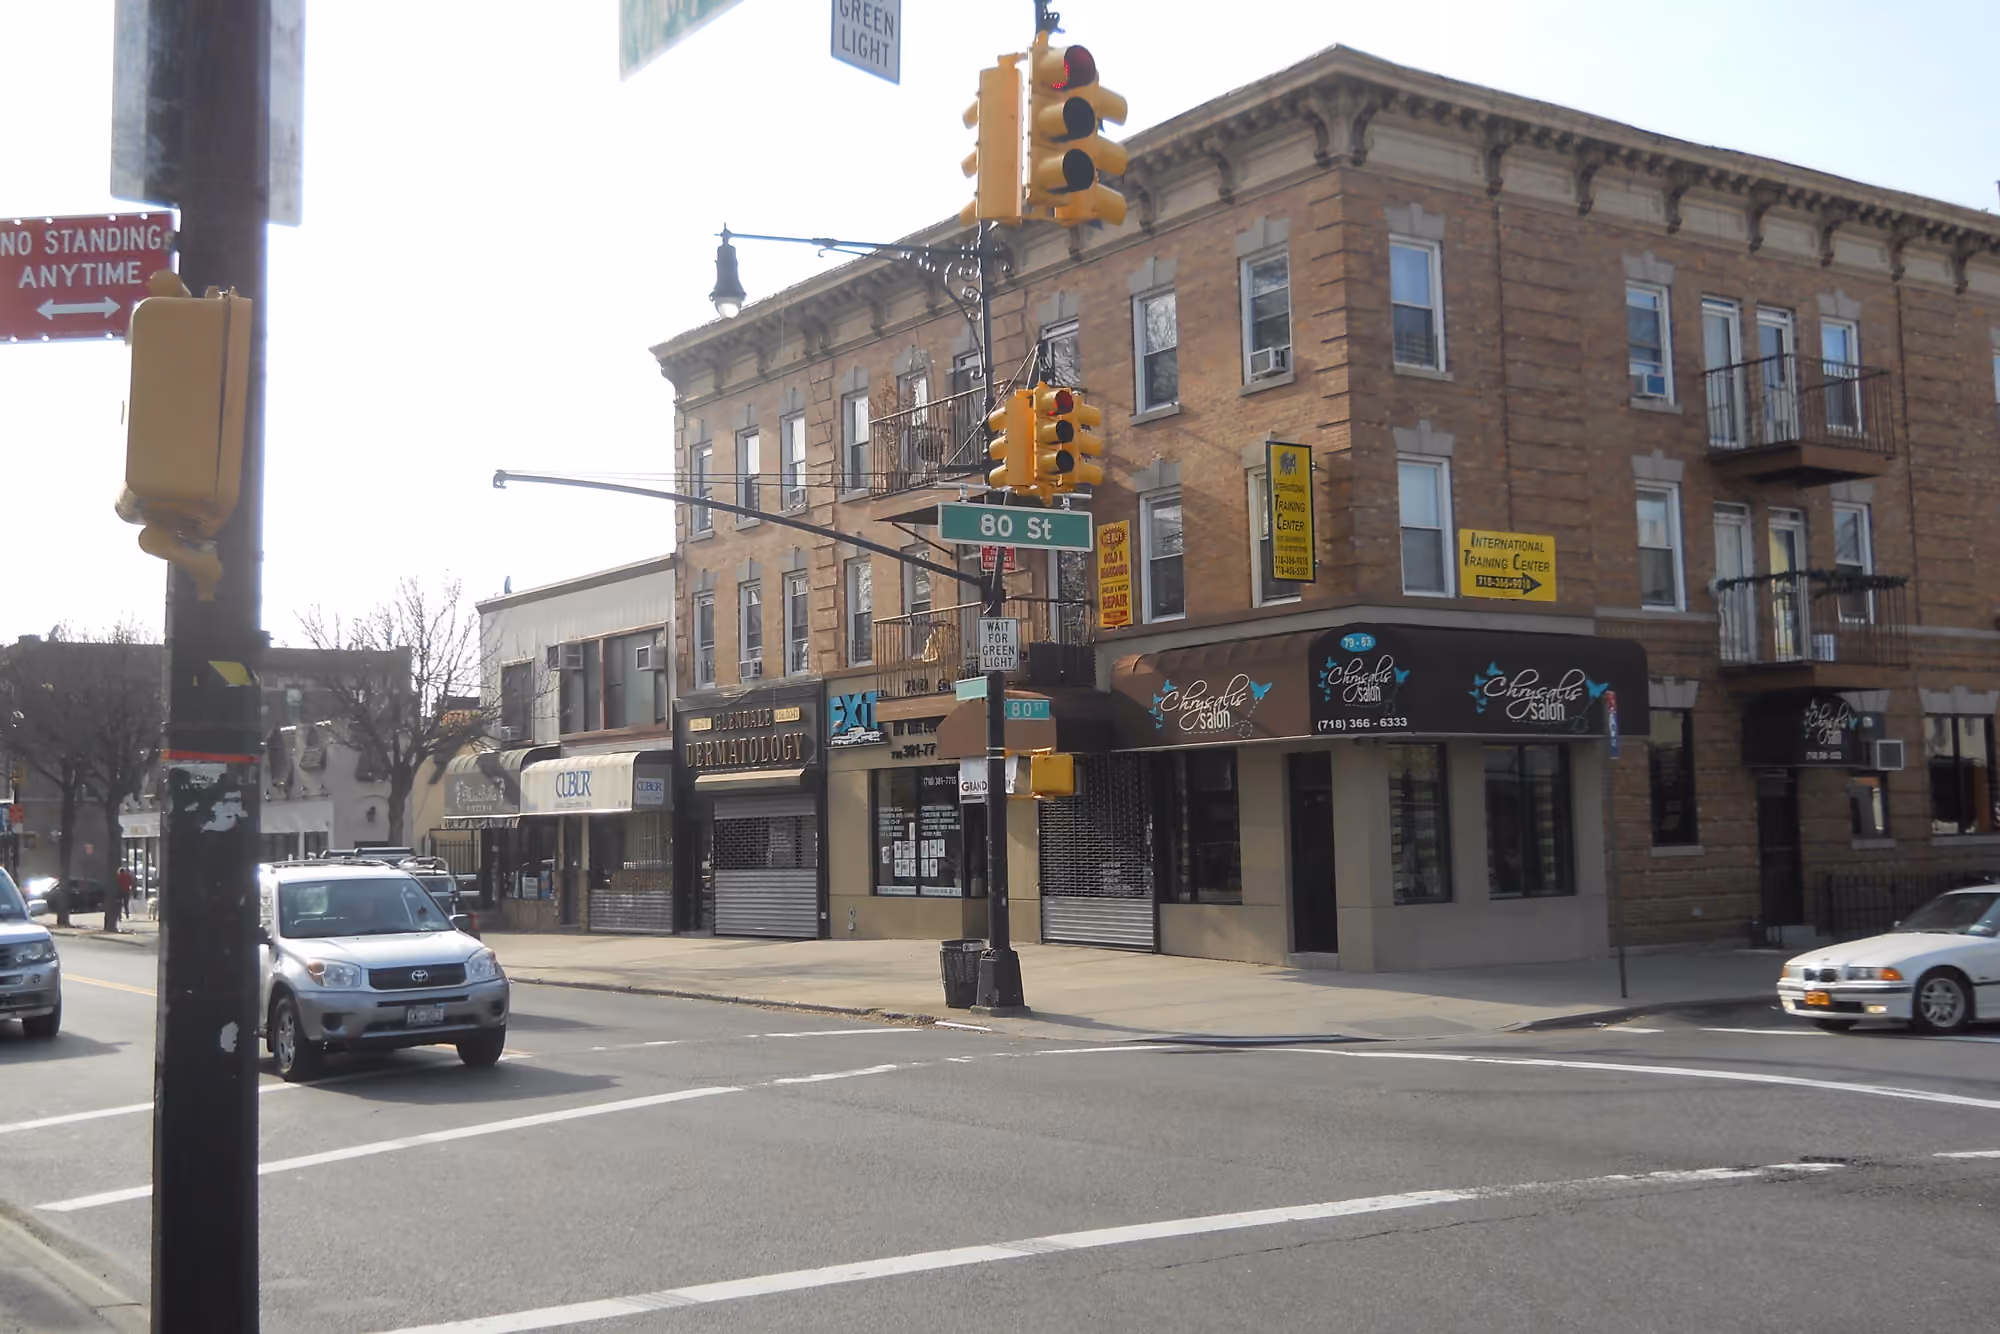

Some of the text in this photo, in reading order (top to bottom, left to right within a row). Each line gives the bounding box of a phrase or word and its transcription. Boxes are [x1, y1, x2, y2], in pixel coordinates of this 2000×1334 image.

[840, 0, 893, 40] GREEN
[842, 24, 890, 68] LIGHT
[1, 225, 161, 256] NO STANDING
[18, 261, 143, 289] ANYTIME
[1274, 494, 1306, 513] TRAINING
[980, 513, 1053, 540] 80 St
[1276, 513, 1305, 531] CENTER
[1471, 532, 1545, 553] INTERNATIONAL
[1464, 550, 1551, 573] TRAINING CENTER
[1103, 593, 1128, 610] REPAIR
[986, 621, 1010, 632] WAIT
[988, 633, 1009, 644] FOR
[982, 645, 1015, 656] GREEN
[984, 657, 1013, 669] LIGHT
[1327, 655, 1394, 703] Chrysalis
[1160, 673, 1250, 731] Chrysalis
[1357, 685, 1382, 703] salon
[1483, 668, 1586, 719] Chrysalis
[715, 708, 772, 731] GLENDALE
[1012, 702, 1043, 717] 80 ST
[1199, 706, 1231, 730] salon
[1530, 700, 1565, 721] salon
[1318, 719, 1346, 732] (718)
[1349, 718, 1370, 729] 366
[1380, 717, 1408, 728] 6333
[686, 733, 804, 768] DERMATOLOGY
[961, 780, 988, 792] GRAND
